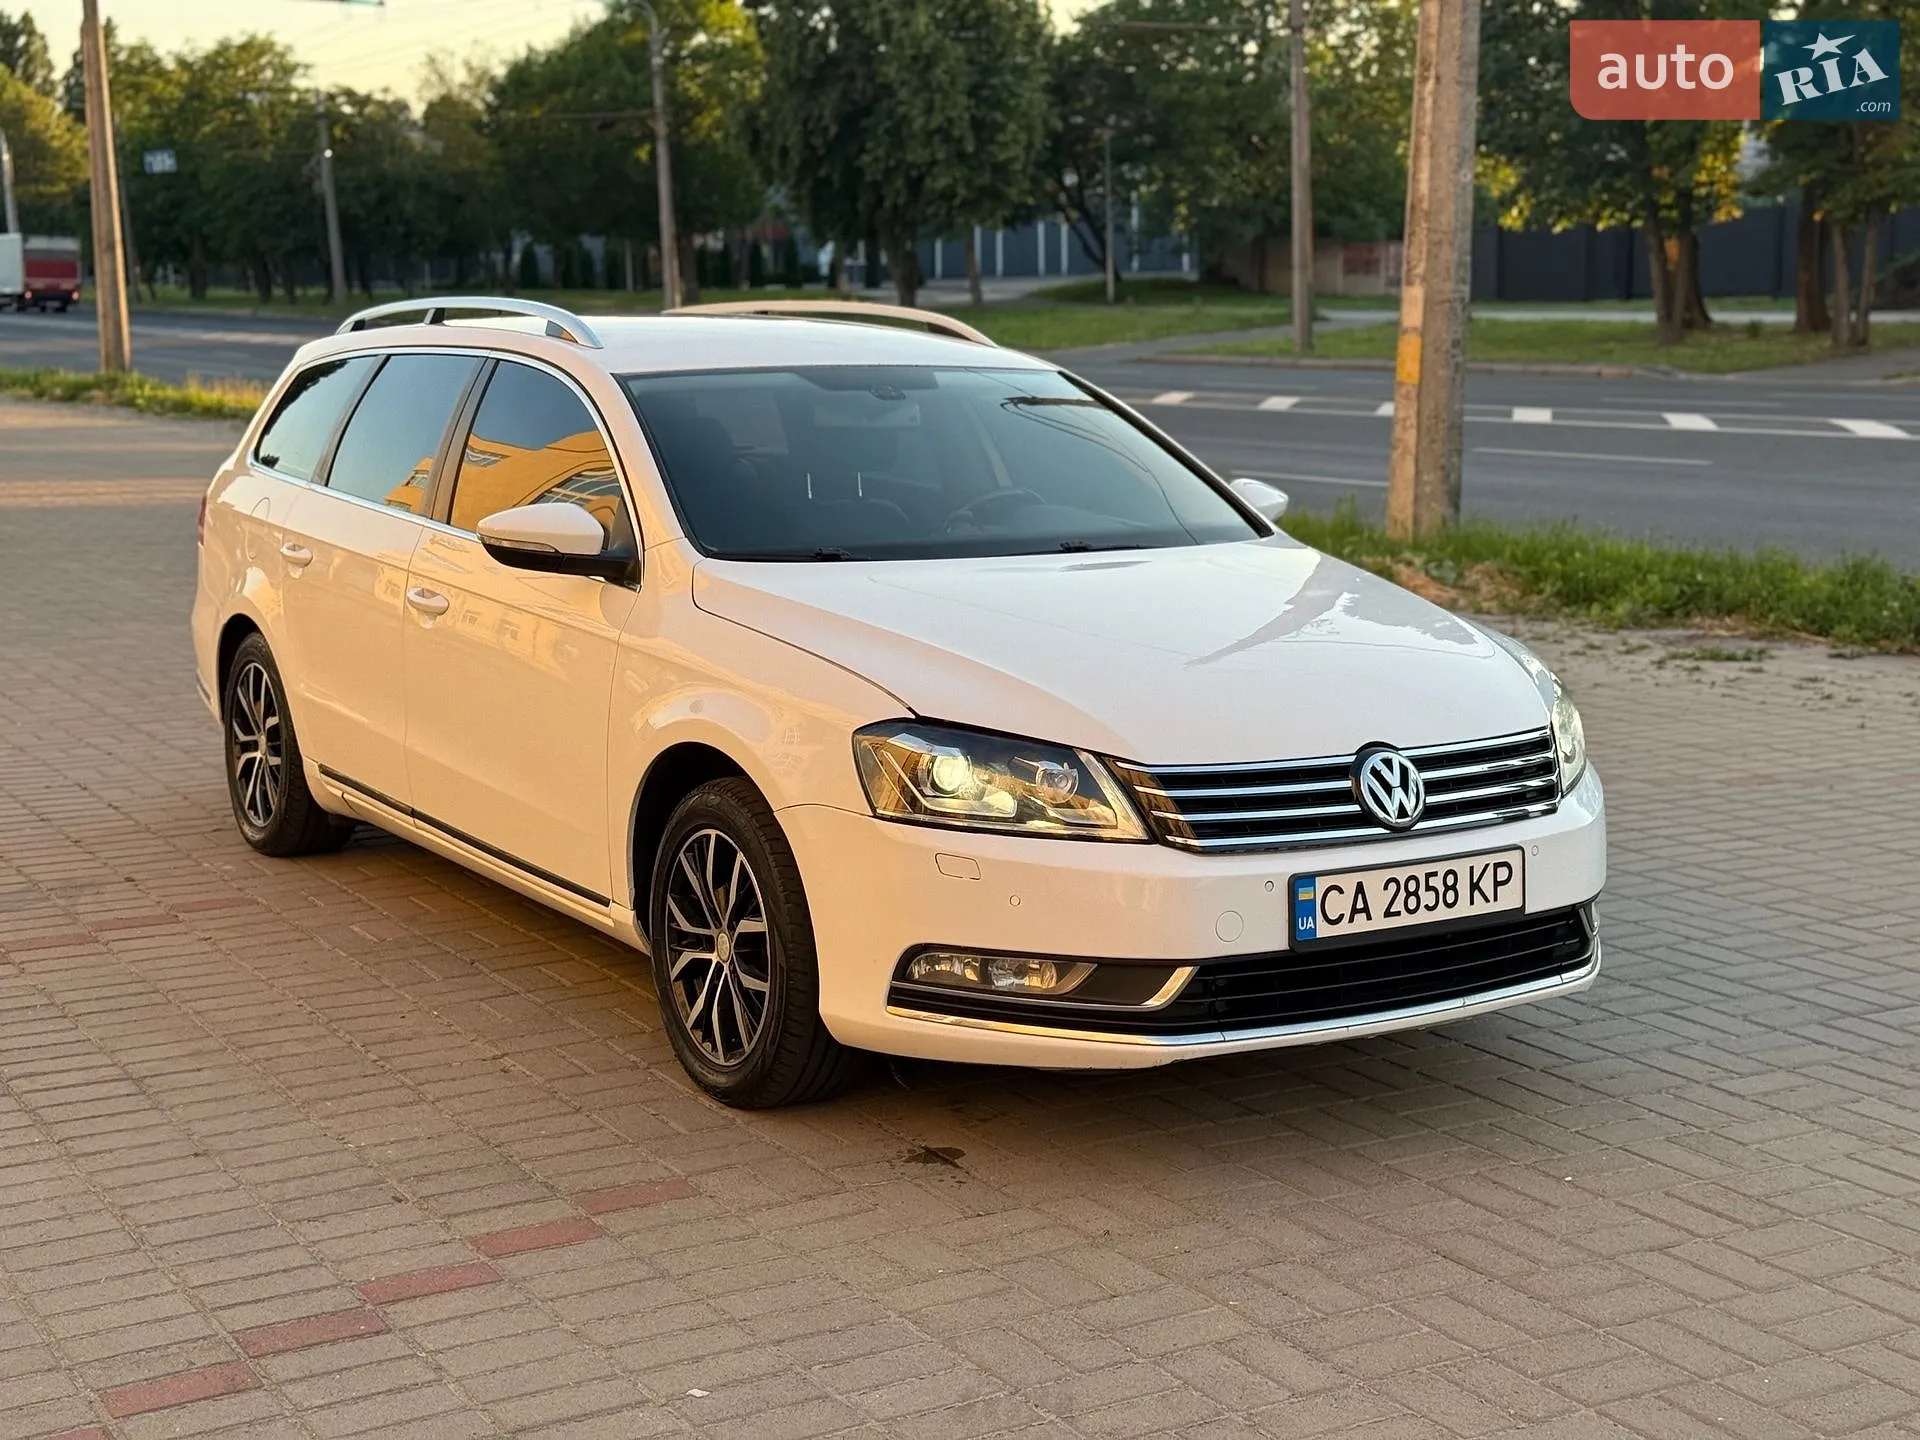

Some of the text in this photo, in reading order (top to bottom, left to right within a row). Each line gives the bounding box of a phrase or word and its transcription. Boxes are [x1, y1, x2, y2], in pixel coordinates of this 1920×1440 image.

[1320, 861, 1513, 926] CA 2858 KP
[1298, 916, 1315, 930] UA
